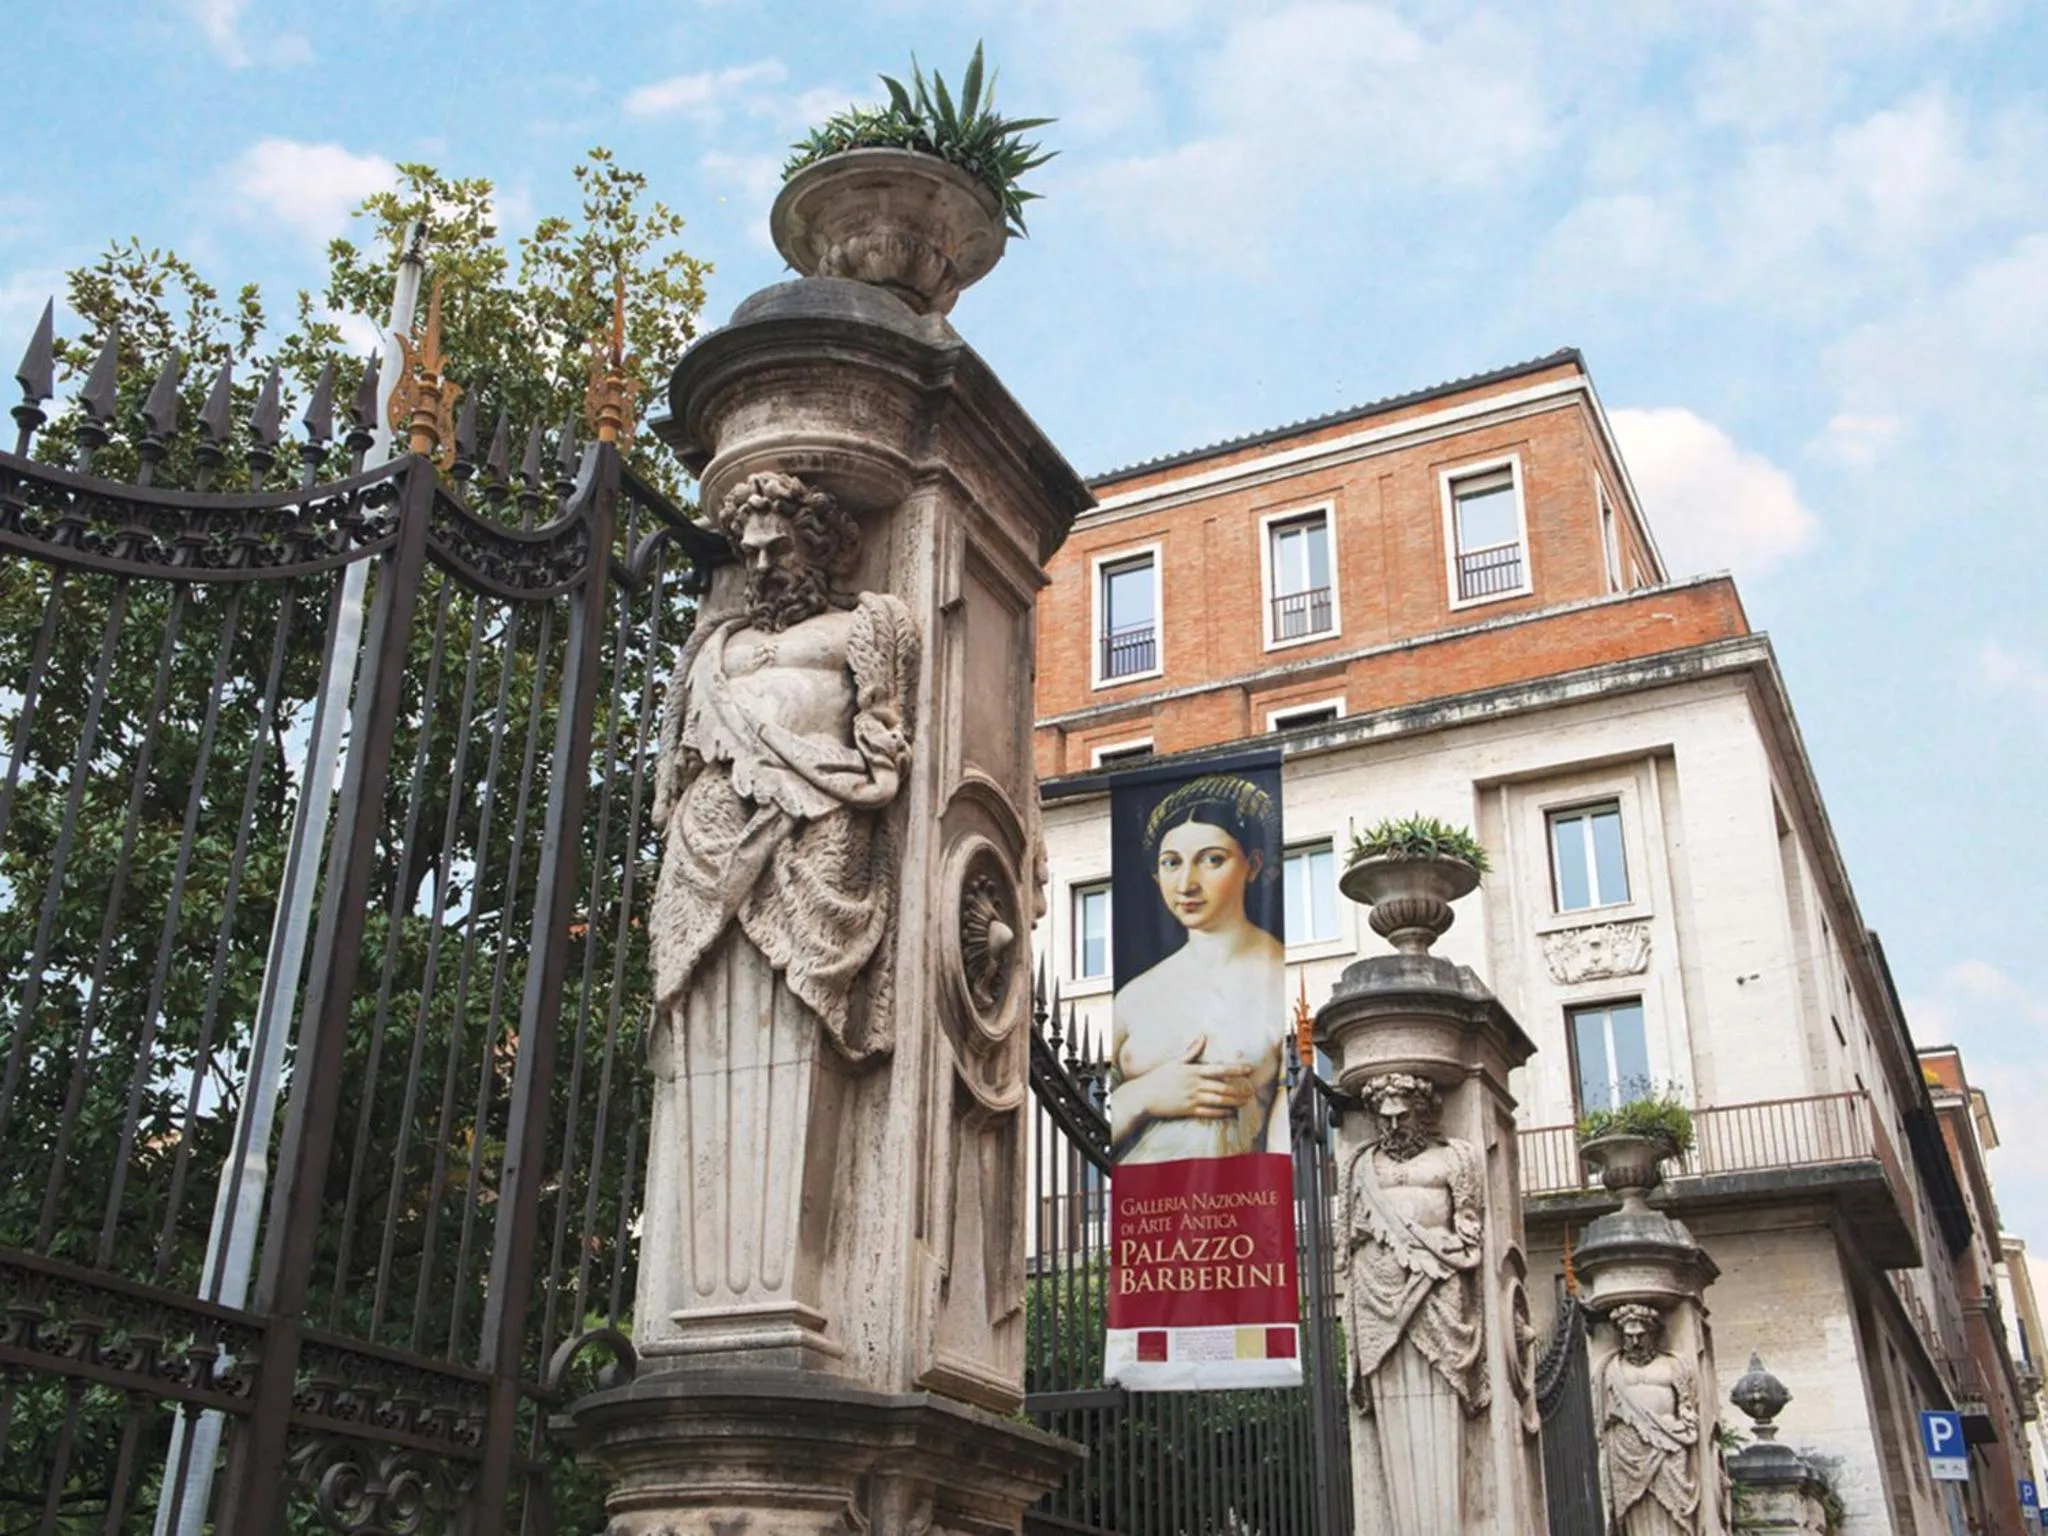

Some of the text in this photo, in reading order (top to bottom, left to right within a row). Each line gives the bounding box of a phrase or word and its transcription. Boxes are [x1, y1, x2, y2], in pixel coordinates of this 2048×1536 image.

[1121, 1191, 1277, 1216] GALLERIA NAZIONALE
[1137, 1217, 1172, 1234] ARTE
[1181, 1214, 1237, 1231] ANTICA
[1120, 1234, 1254, 1266] PALAZZO
[1119, 1263, 1286, 1295] BARBERINI
[1928, 1417, 1953, 1452] P
[2022, 1484, 2033, 1501] P
